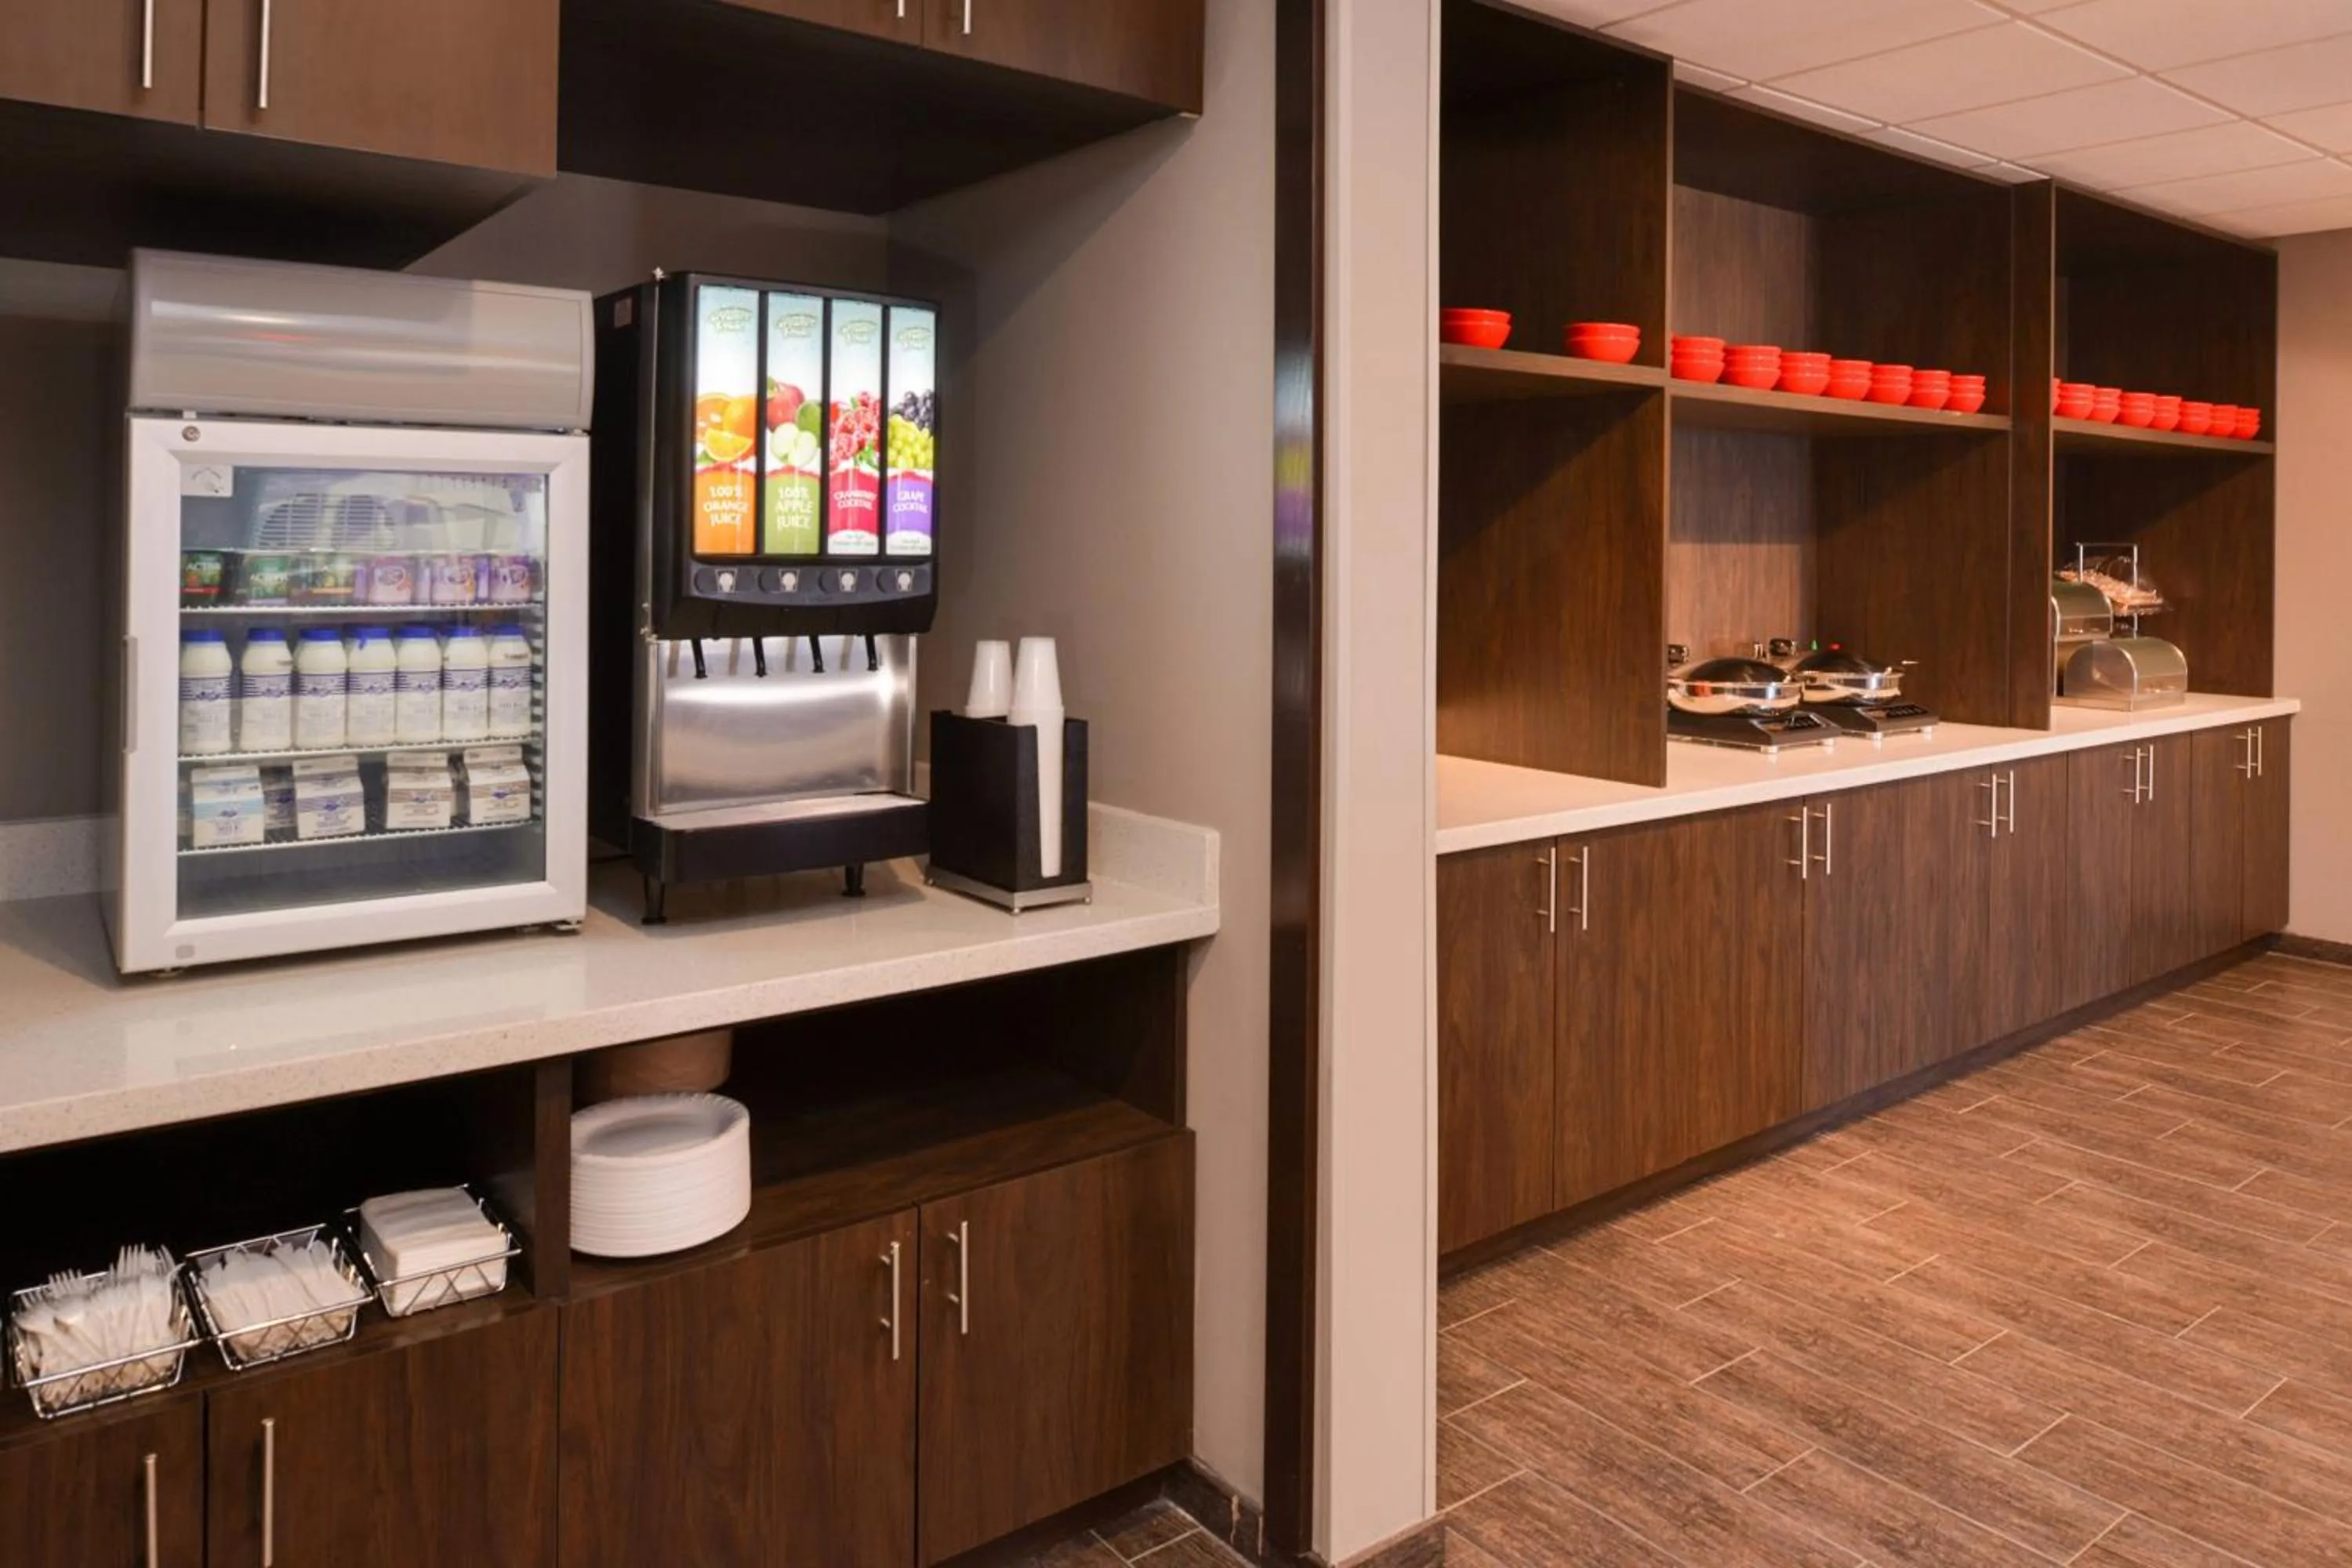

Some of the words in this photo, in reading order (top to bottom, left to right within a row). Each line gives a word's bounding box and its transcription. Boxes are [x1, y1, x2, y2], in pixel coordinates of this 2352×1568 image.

[702, 499, 749, 514] ORANGE
[774, 499, 813, 515] APPLE
[710, 512, 741, 527] JUICE
[777, 515, 811, 530] JUICE
